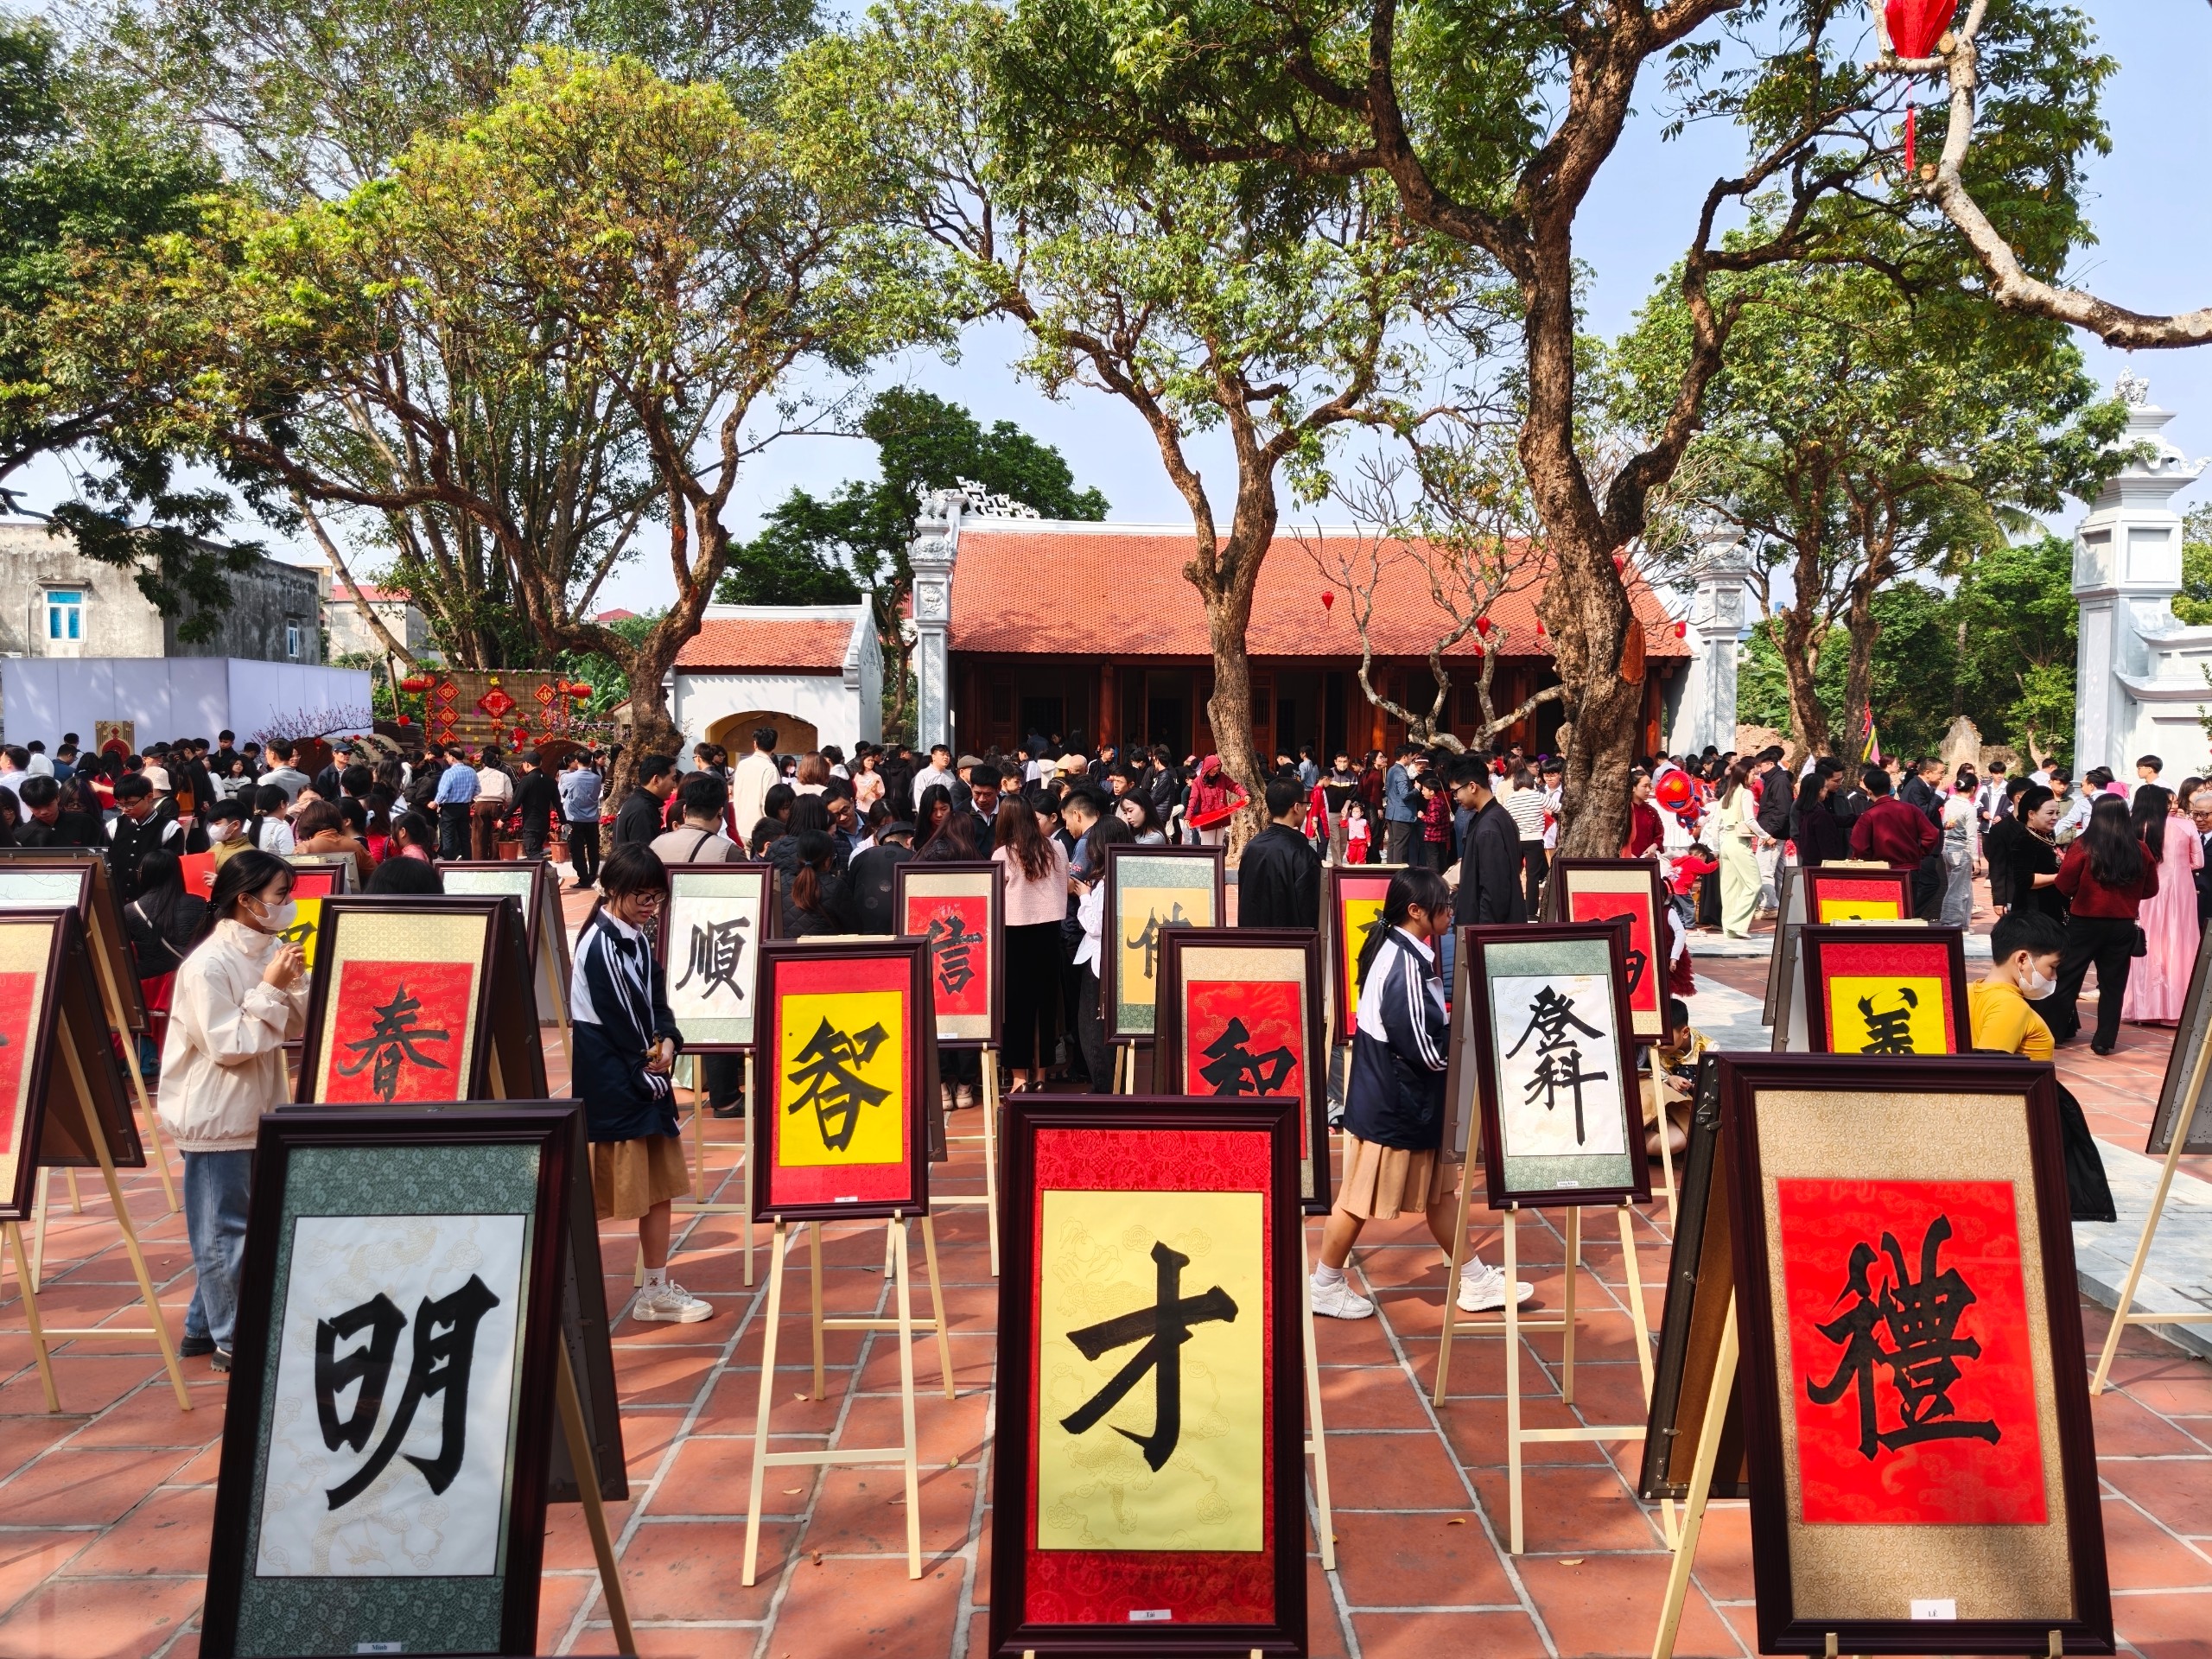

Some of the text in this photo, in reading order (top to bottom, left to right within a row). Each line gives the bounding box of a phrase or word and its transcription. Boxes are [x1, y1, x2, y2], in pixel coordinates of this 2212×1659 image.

[441, 686, 455, 697] CHÚC
[675, 916, 752, 1000] 順
[337, 982, 449, 1103] 春
[788, 1015, 893, 1152] 智
[1506, 985, 1608, 1146] 登科
[315, 1274, 500, 1510] 明
[1059, 1240, 1239, 1472] 才
[1807, 1213, 2001, 1461] 禮
